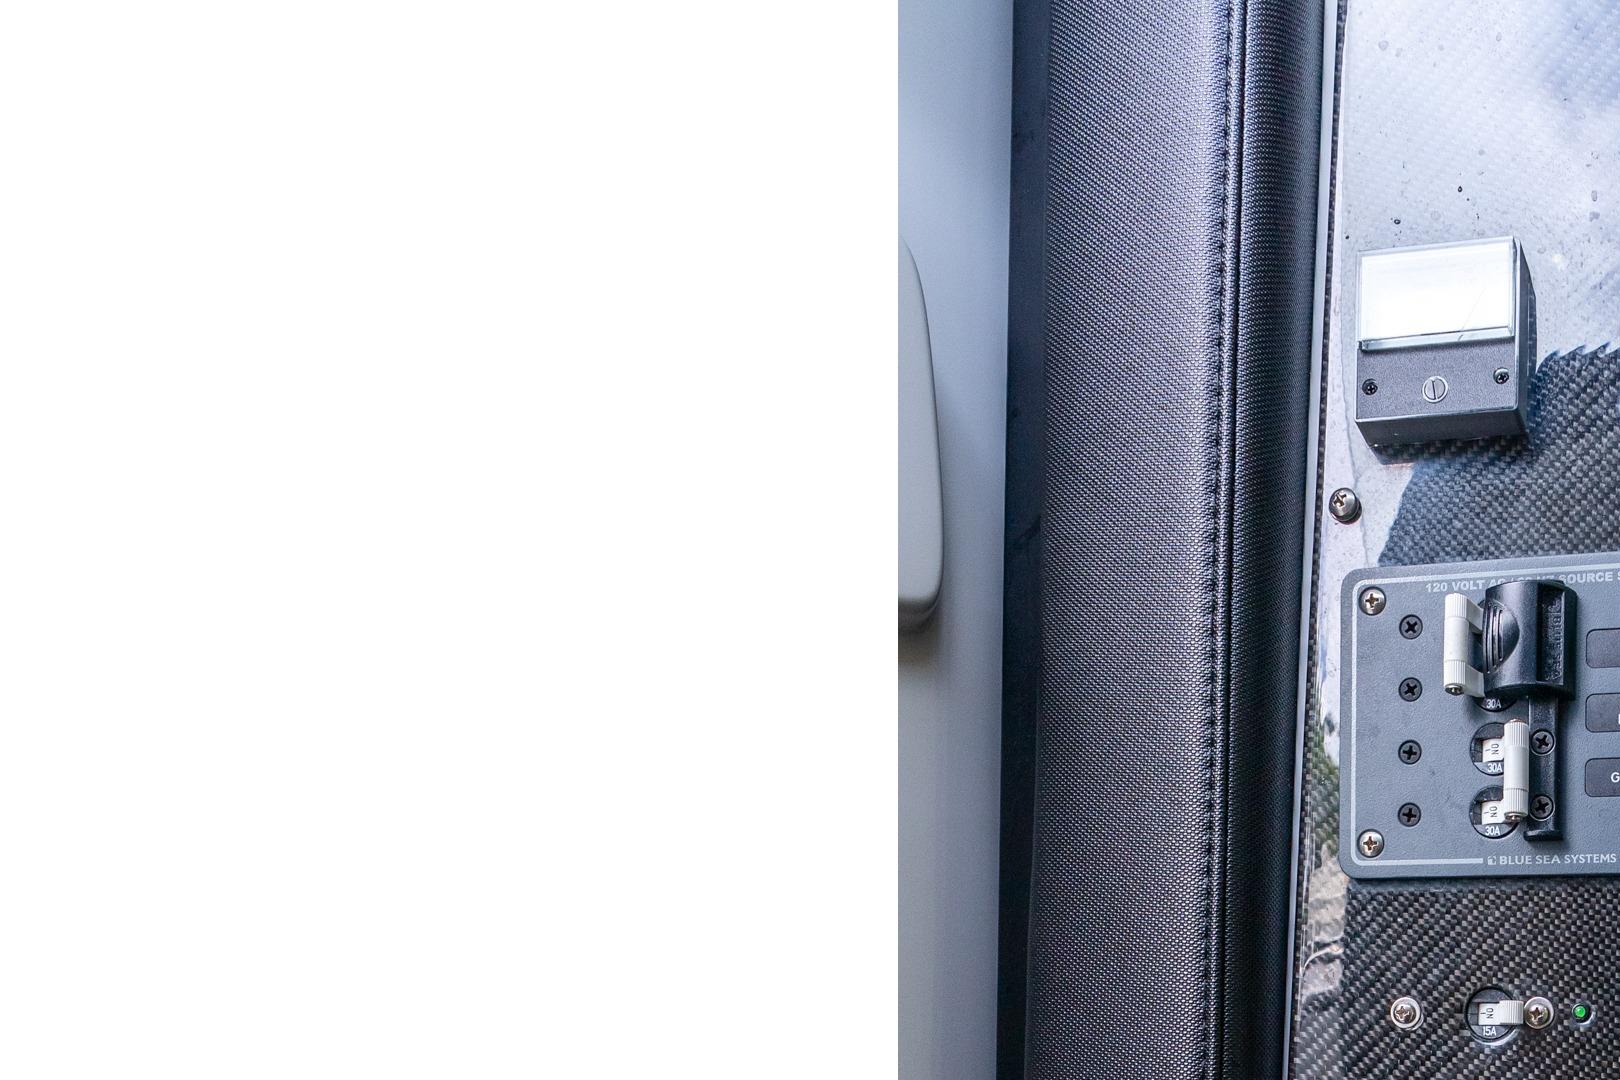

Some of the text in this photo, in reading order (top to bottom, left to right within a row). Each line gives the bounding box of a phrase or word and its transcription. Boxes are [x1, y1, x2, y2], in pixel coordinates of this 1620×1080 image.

[1426, 582, 1447, 593] 120
[1452, 579, 1485, 592] VOLT
[1559, 572, 1614, 585] SOURCE
[1486, 699, 1501, 709] 30A
[1491, 743, 1499, 755] ON
[1487, 763, 1503, 773] 30A
[1490, 805, 1498, 818] ON
[1485, 826, 1501, 836] 30A
[1500, 853, 1617, 865] BLUE SEA SYSTEMS
[1486, 1007, 1494, 1019] ON
[1482, 1026, 1497, 1036] 15A
